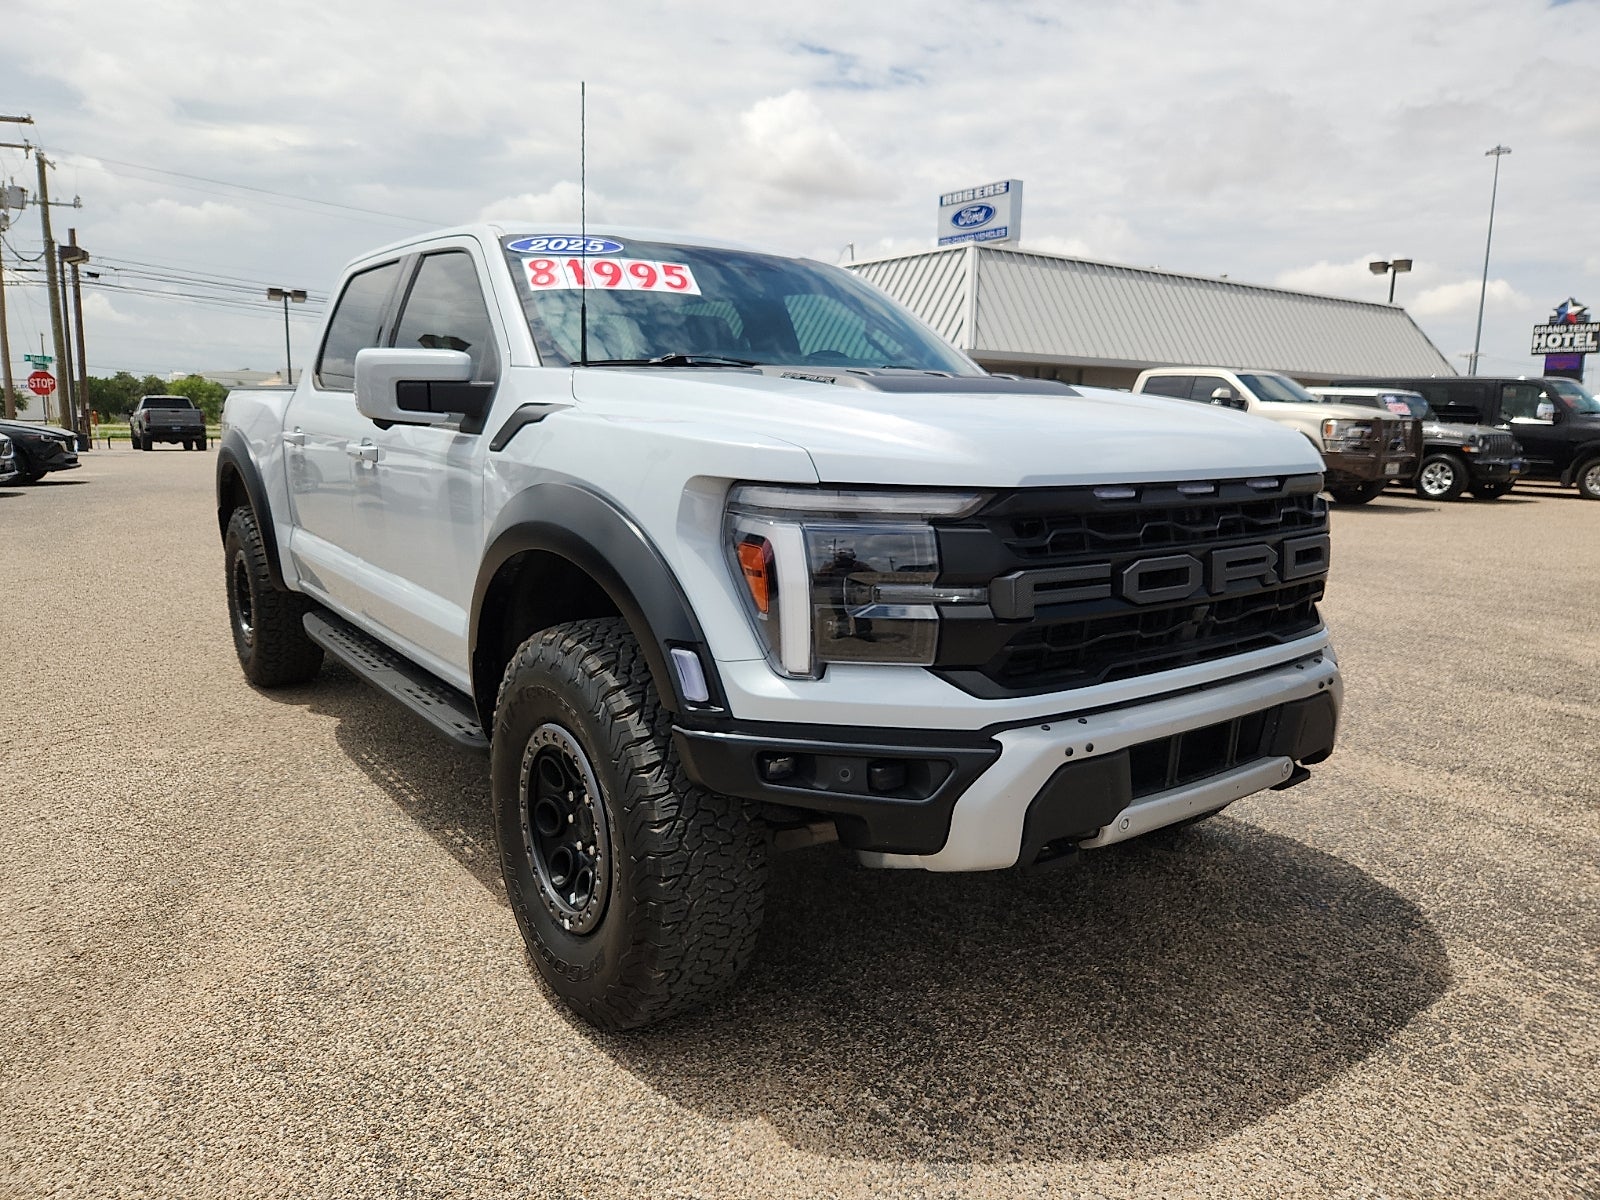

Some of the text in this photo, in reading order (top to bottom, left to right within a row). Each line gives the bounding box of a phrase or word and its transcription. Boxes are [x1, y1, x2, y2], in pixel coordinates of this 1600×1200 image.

[943, 182, 1007, 206] ROGERS
[958, 207, 987, 226] Ford
[528, 238, 606, 252] 2025
[528, 258, 692, 291] 81995
[1534, 323, 1600, 334] GRAND TEXAN
[1533, 331, 1598, 349] HOTEL
[29, 377, 54, 389] STOP
[990, 533, 1331, 623] FORD
